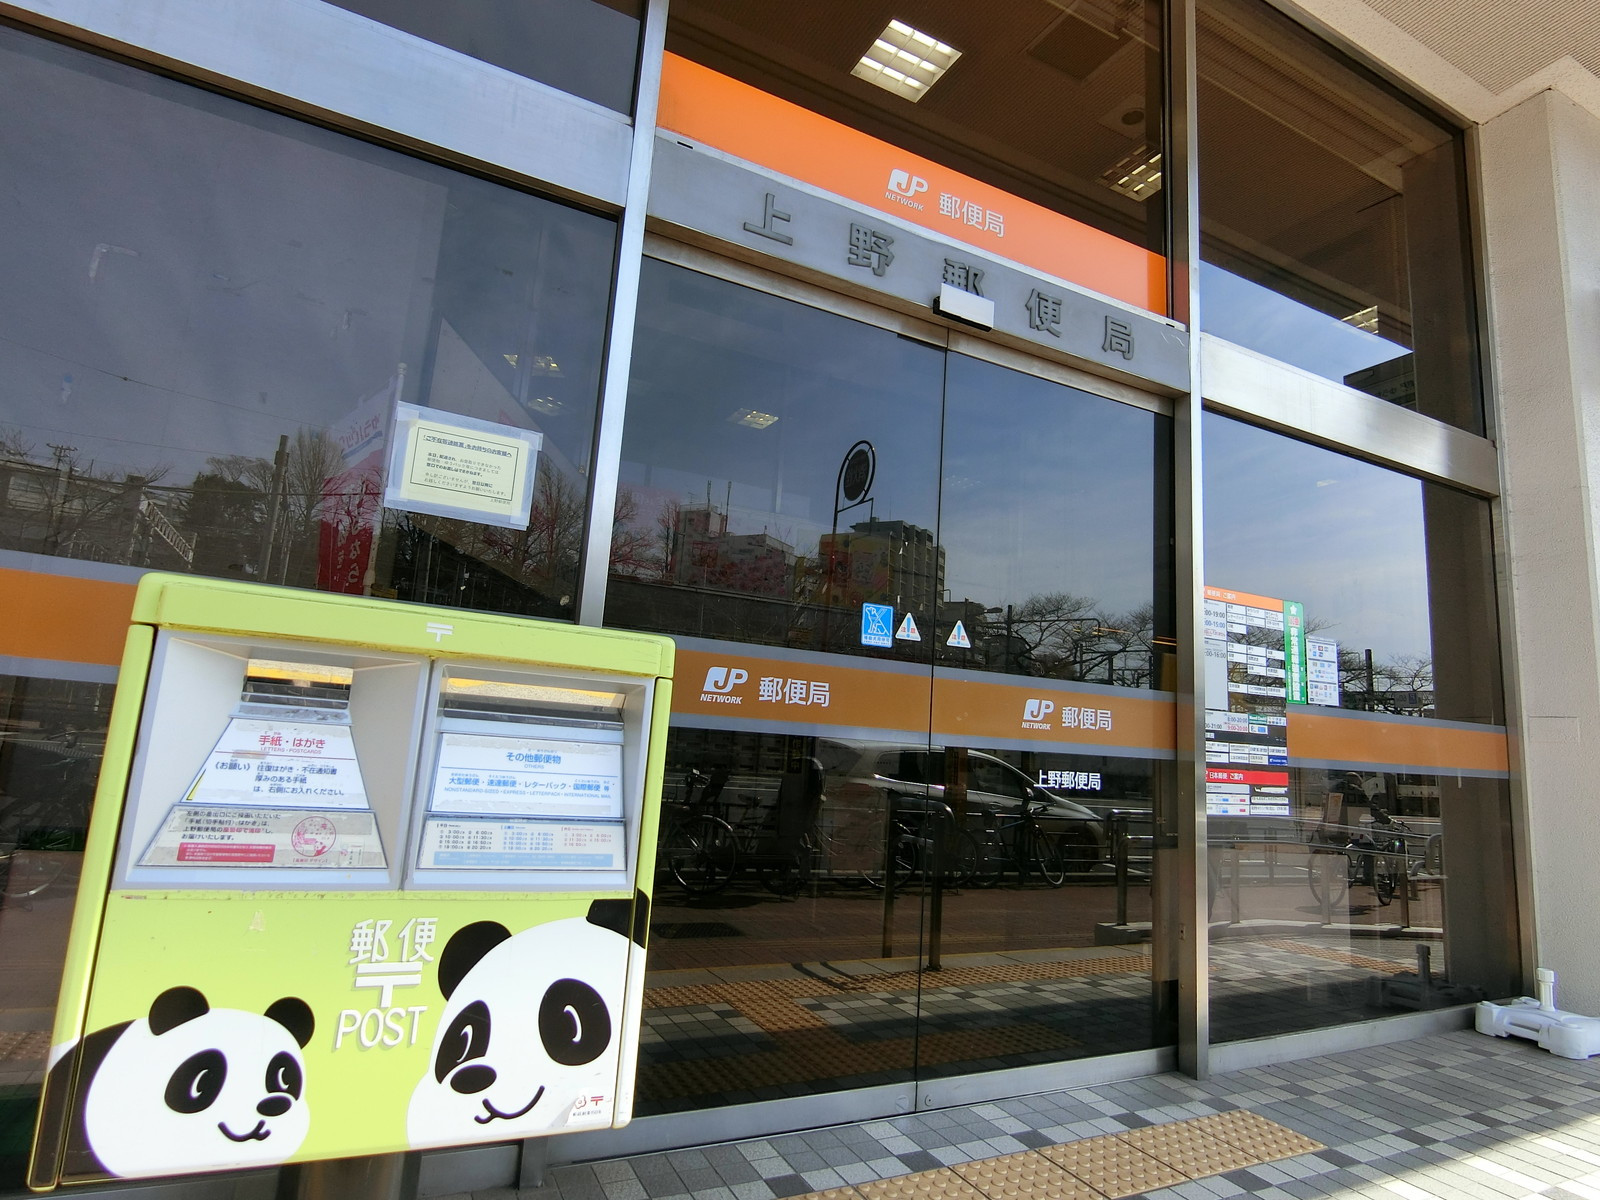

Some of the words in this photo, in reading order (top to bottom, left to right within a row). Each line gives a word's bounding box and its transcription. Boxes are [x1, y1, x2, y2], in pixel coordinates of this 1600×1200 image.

[887, 168, 929, 197] JP
[884, 191, 924, 212] NETWORK
[939, 192, 1005, 238] 郵便局
[1204, 609, 1226, 619] :00-19:00
[1204, 619, 1226, 629] :00-15:00
[703, 666, 749, 693] JP
[700, 693, 743, 705] NETWORK
[758, 676, 830, 708] 郵便局
[1023, 698, 1055, 721] JP
[1061, 706, 1113, 731] 郵便局
[1021, 721, 1052, 731] NETWORK
[258, 735, 326, 749] 手紙・はがき
[506, 752, 562, 765] その他郵便物
[254, 775, 307, 784] 厚みのある手紙
[1033, 769, 1102, 791] 上野郵便局
[348, 917, 439, 965] 郵便
[335, 1005, 429, 1050] POST
